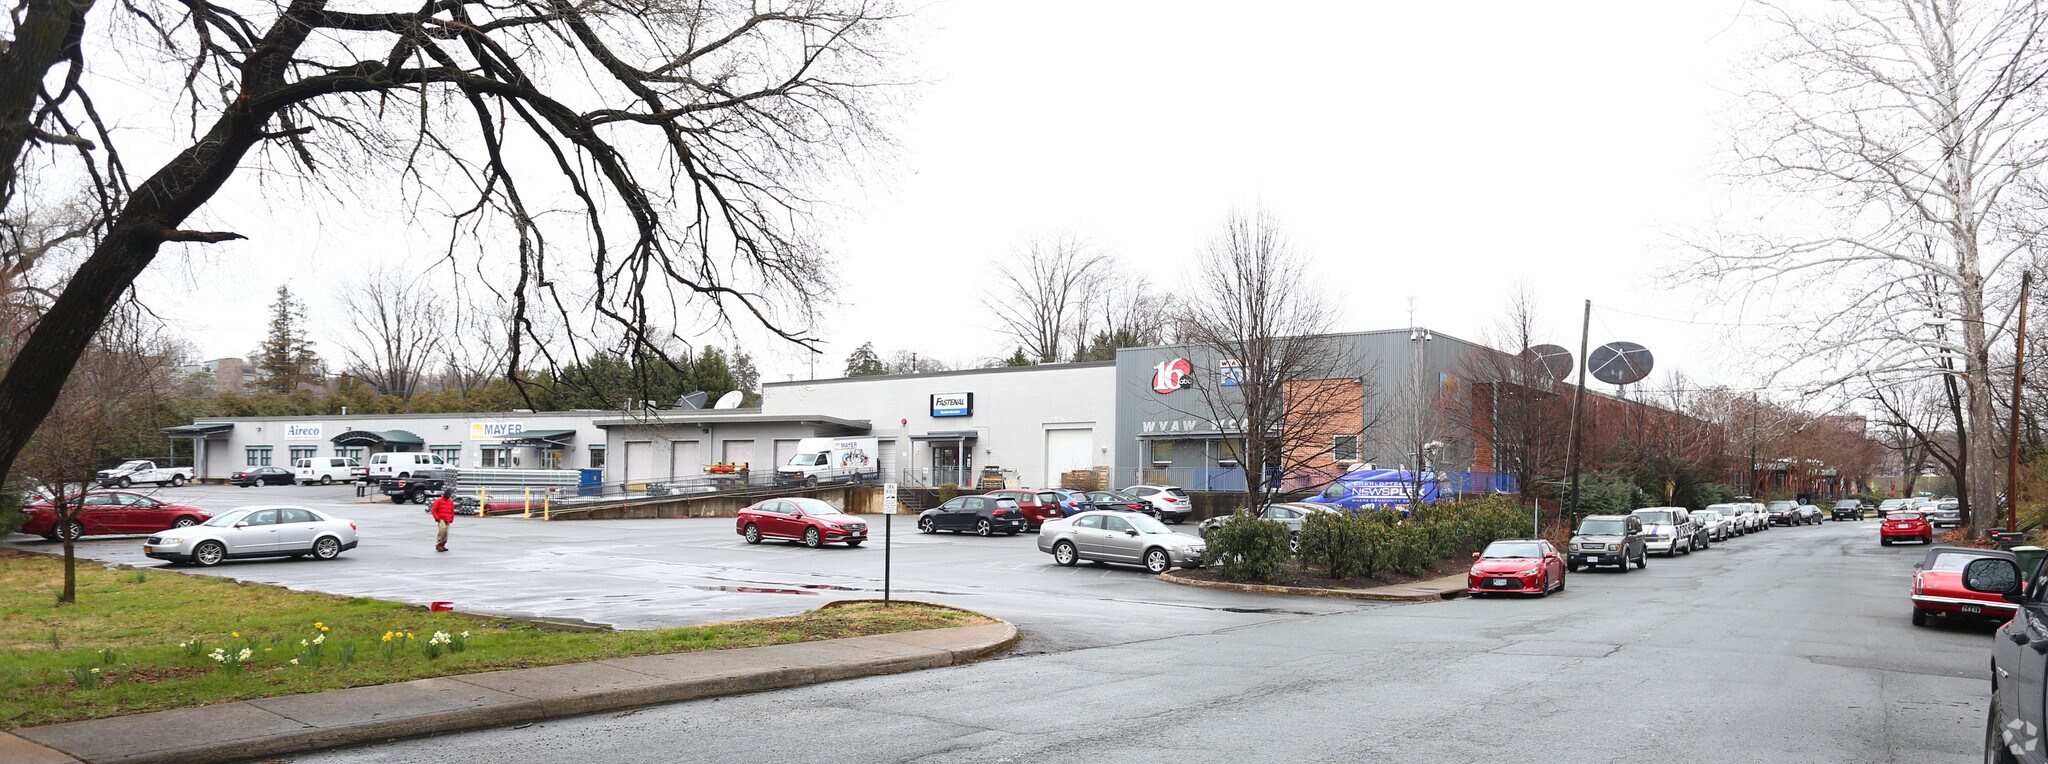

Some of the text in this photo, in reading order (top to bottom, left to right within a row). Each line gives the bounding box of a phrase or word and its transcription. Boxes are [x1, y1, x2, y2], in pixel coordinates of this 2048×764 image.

[1154, 358, 1184, 389] 16
[288, 425, 320, 435] Aireco
[484, 424, 522, 434] MAYER
[1143, 418, 1264, 432] WVAW WCA
